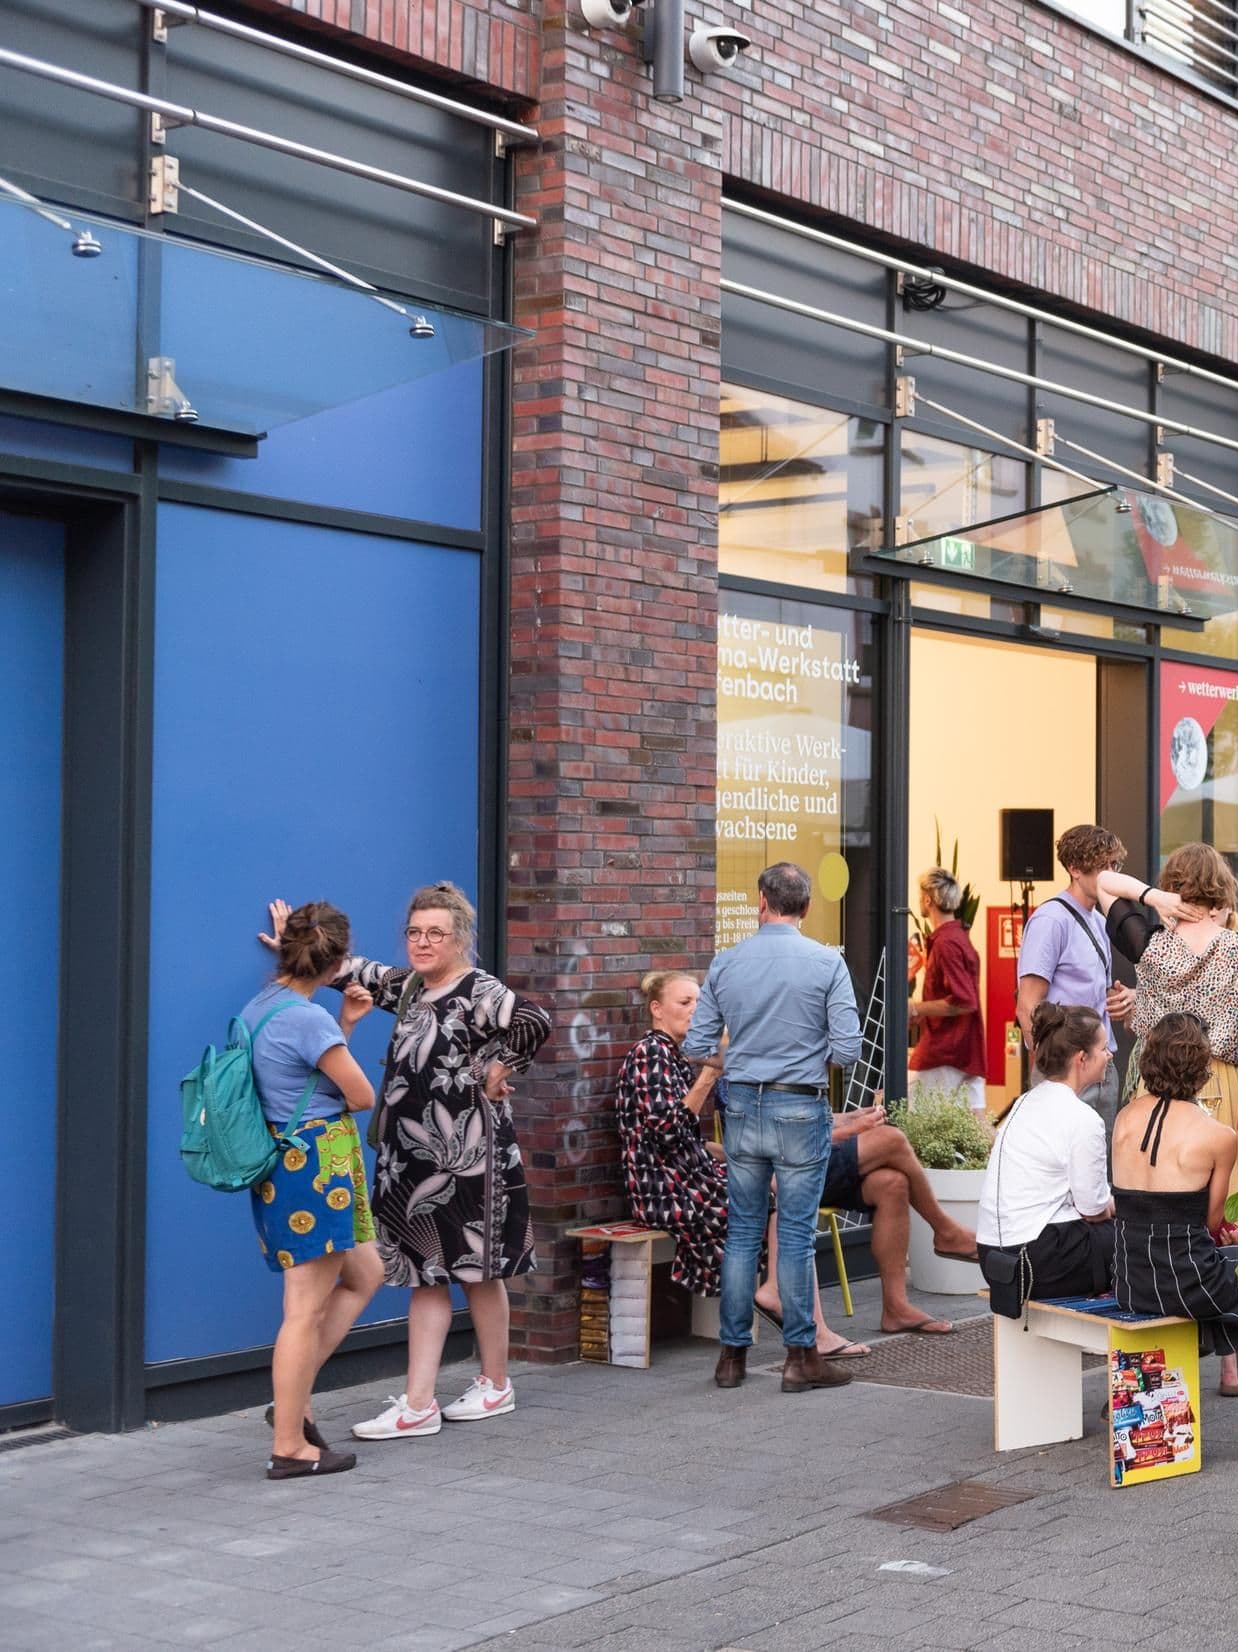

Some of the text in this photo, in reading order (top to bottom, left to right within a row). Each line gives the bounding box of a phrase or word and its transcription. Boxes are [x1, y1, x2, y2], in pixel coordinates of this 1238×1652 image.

[718, 612, 814, 649] tter- und
[796, 735, 847, 760] Werk-
[735, 756, 763, 782] für
[767, 759, 830, 790] Kinder,
[805, 792, 838, 815] und
